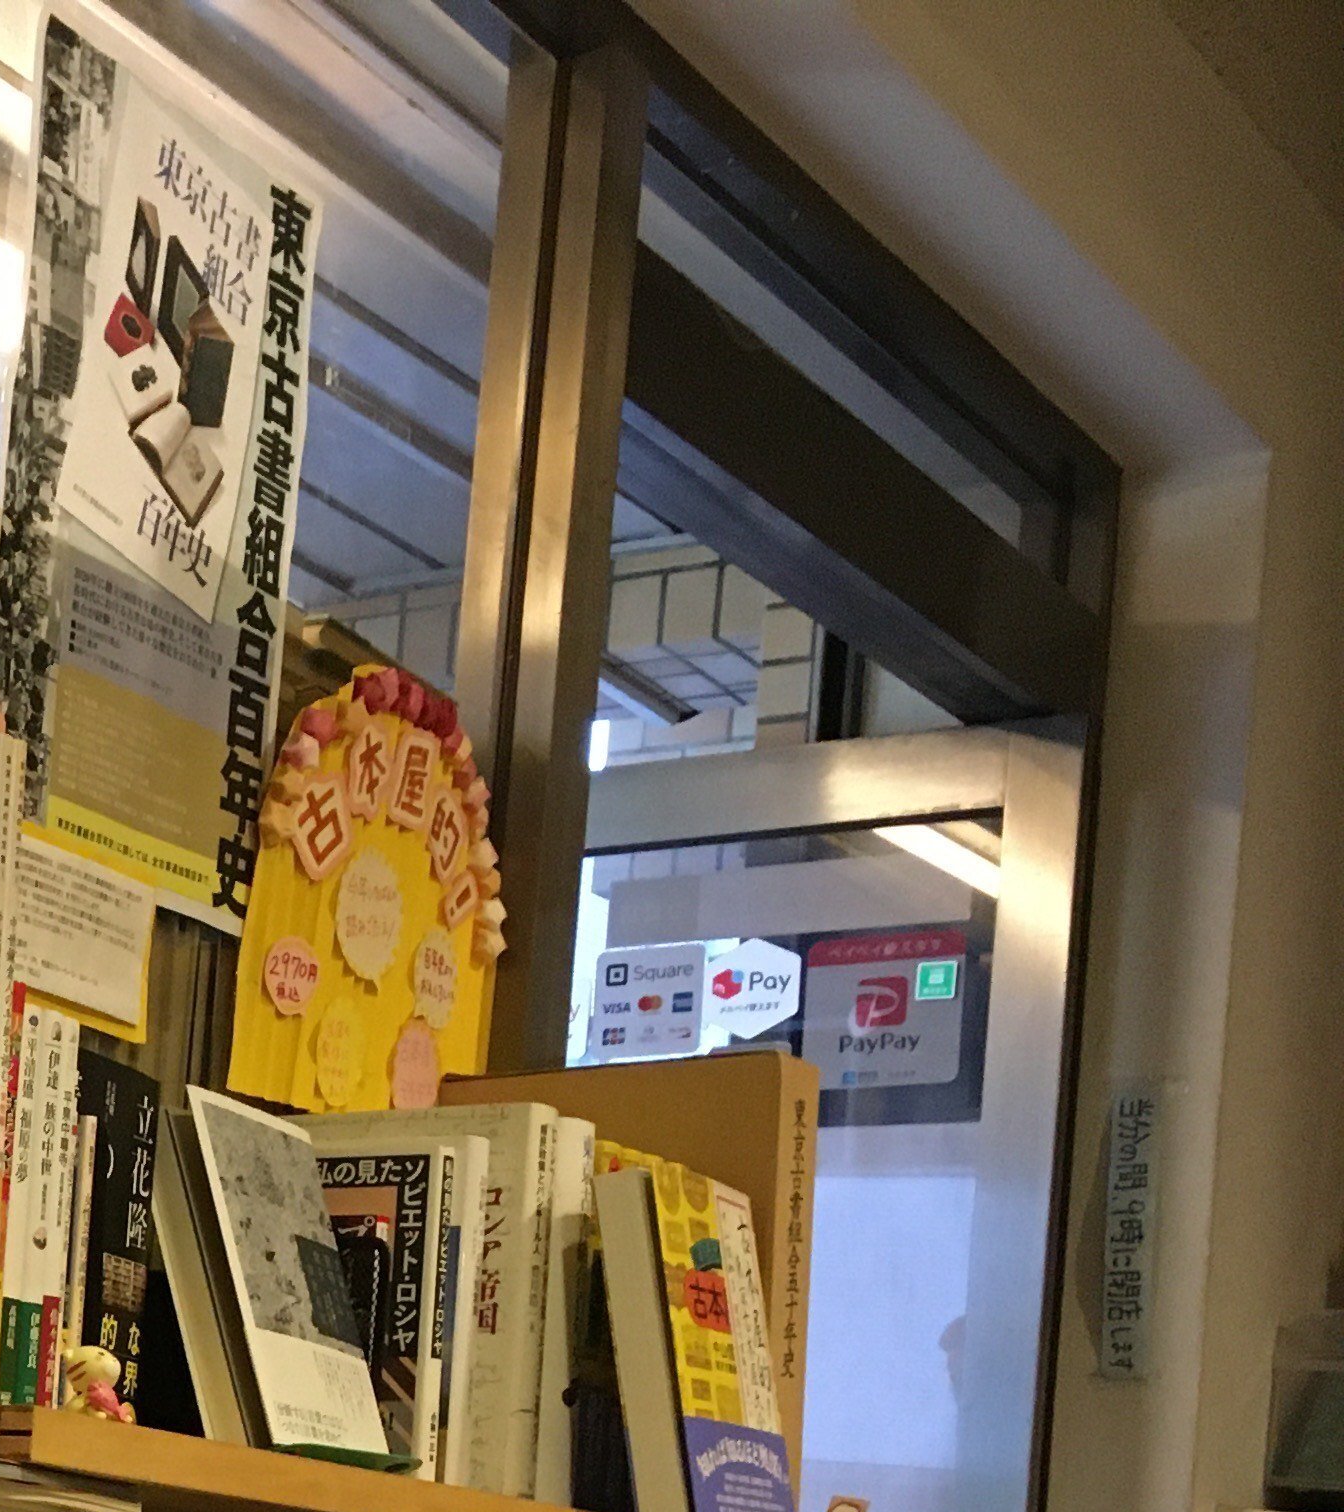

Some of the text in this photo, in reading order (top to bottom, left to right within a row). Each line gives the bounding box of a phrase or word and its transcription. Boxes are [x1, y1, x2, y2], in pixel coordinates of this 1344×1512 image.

[152, 136, 263, 274] 東京古書
[200, 242, 255, 329] 組合
[135, 489, 213, 589] 百年史
[212, 182, 313, 919] 東京古書組合百年史
[293, 727, 479, 930] 古本屋的!
[602, 1002, 632, 1015] VISA
[633, 961, 695, 982] Square
[748, 970, 792, 994] Pay
[838, 1032, 921, 1055] PayPay
[124, 1094, 155, 1252] 立花隆
[391, 1157, 427, 1354] ソビエット・ロシヤ
[780, 1098, 807, 1379] 東京古書組合五十年史
